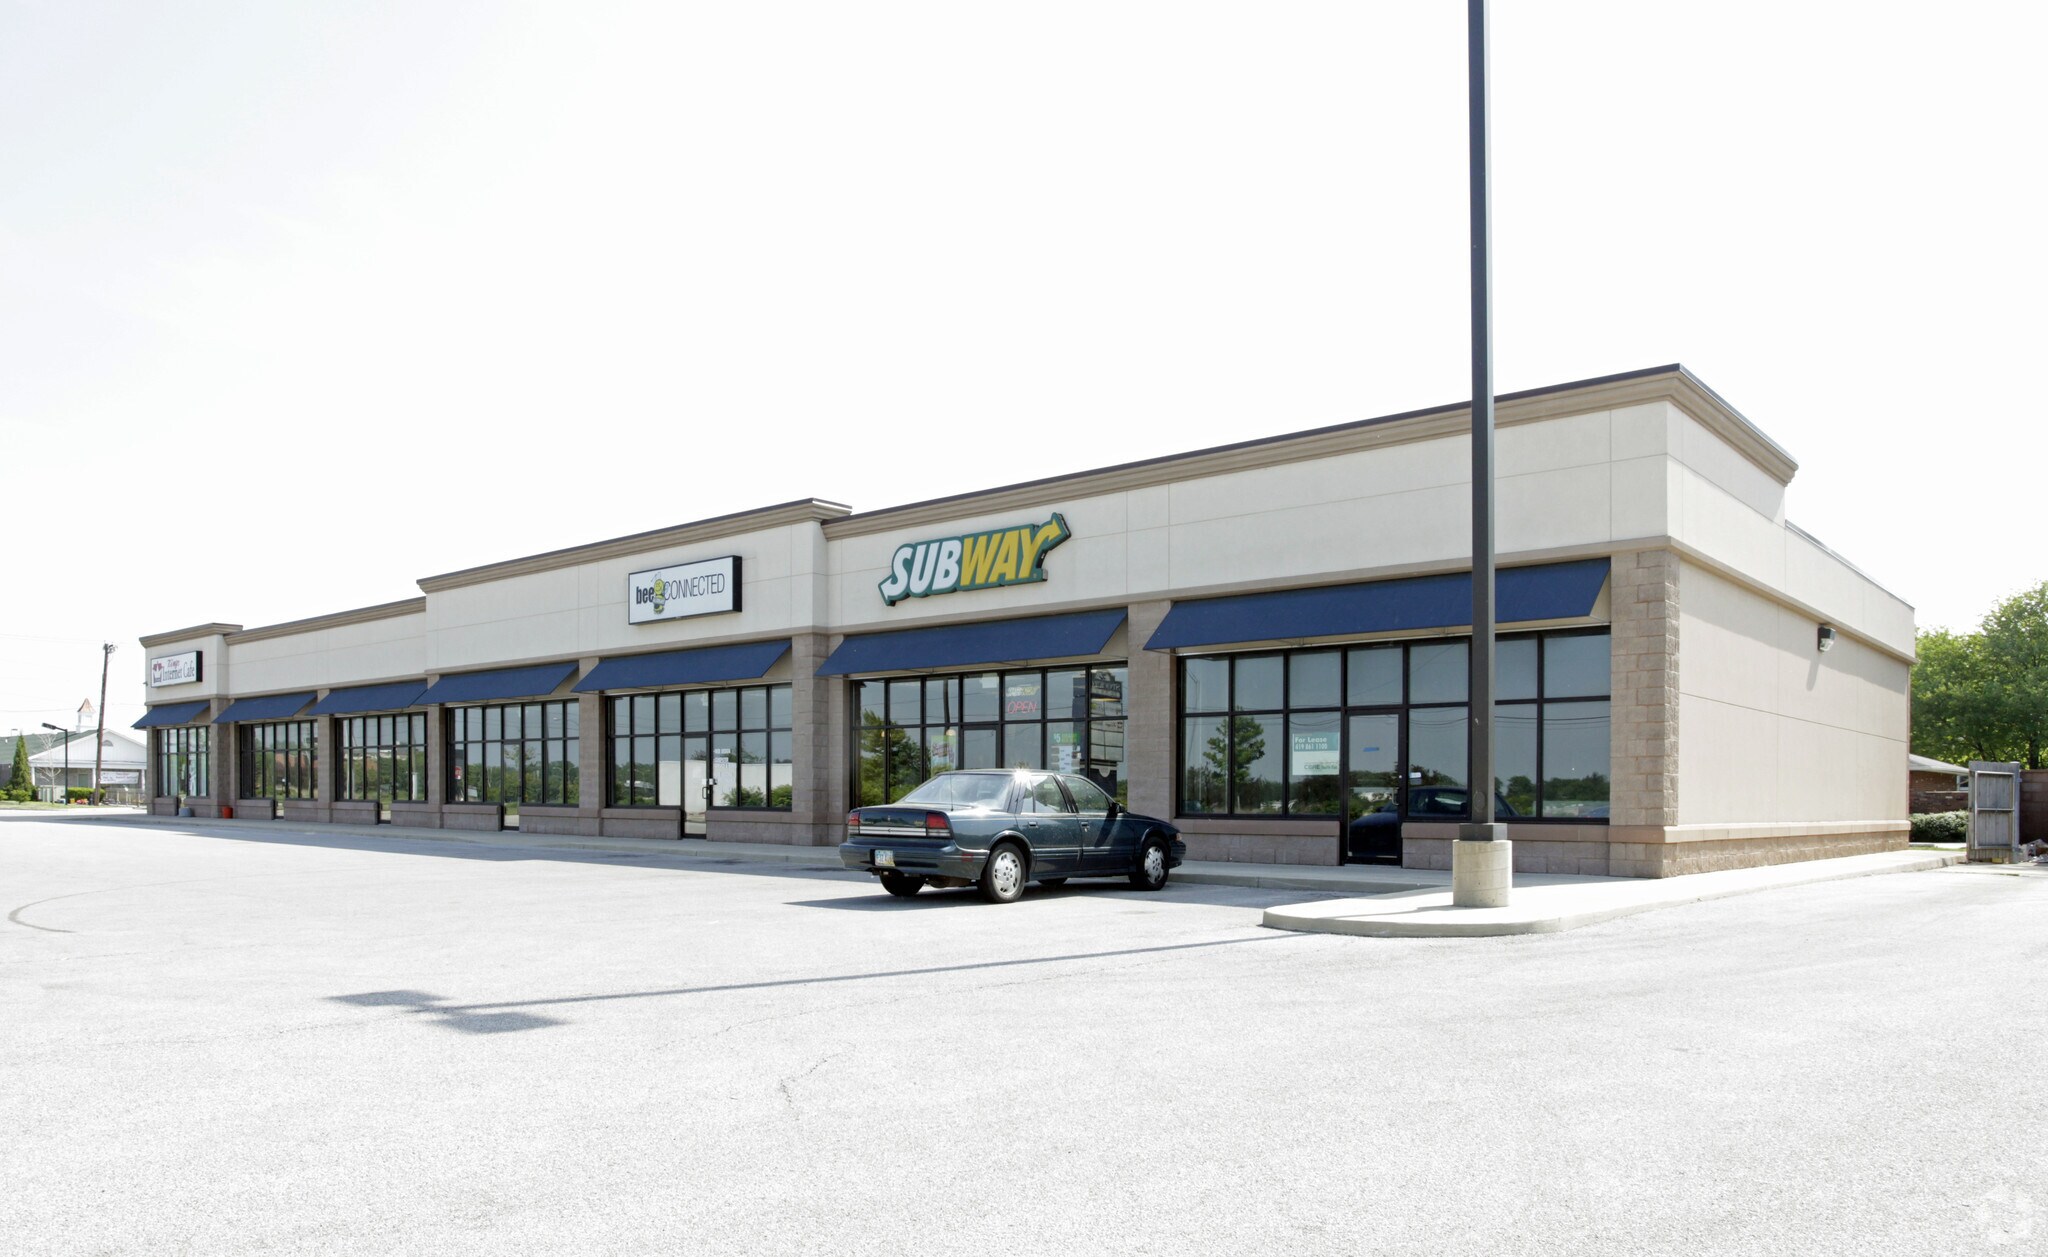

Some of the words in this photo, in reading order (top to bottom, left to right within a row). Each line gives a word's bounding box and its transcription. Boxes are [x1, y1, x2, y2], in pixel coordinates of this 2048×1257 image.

[880, 518, 1062, 600] SUBWAY
[636, 586, 654, 605] bee
[664, 573, 725, 601] CONNECTED
[1008, 701, 1037, 714] OPEN
